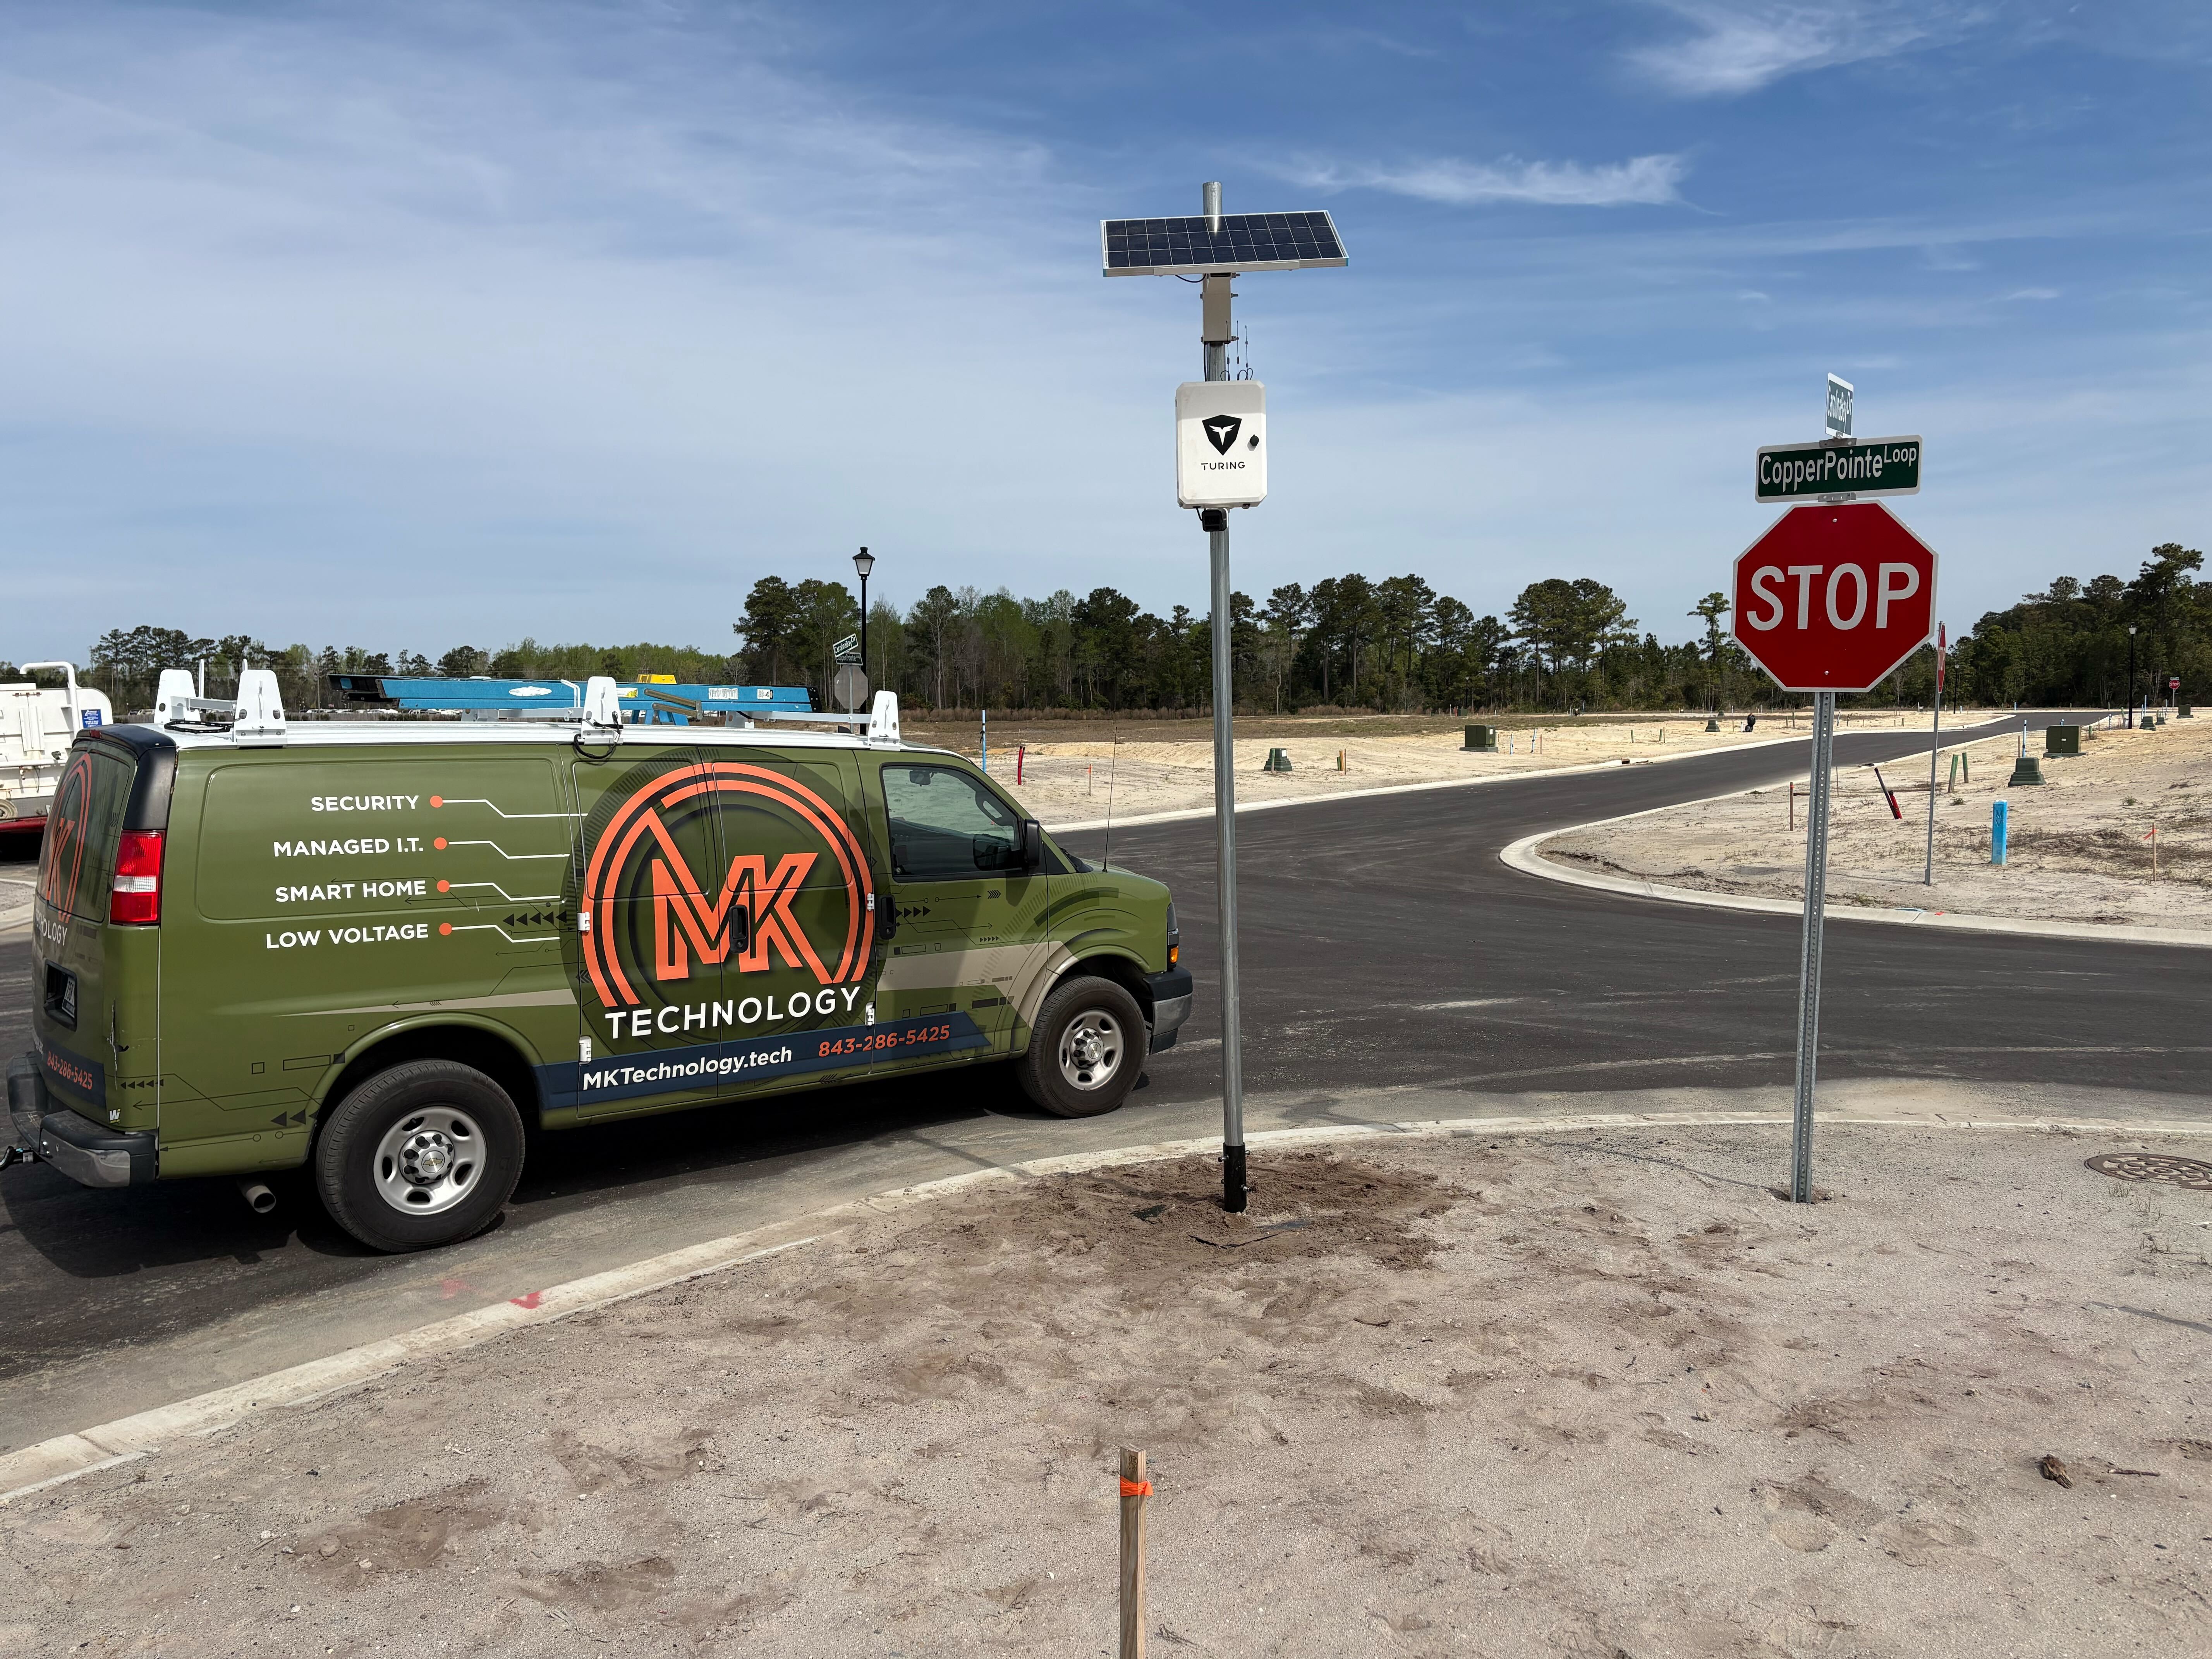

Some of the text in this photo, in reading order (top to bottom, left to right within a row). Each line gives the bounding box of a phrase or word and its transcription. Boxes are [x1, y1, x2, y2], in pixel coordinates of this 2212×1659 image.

[1201, 461, 1245, 471] TURING
[1760, 445, 1917, 493] CopperPointe Loop
[1747, 562, 1920, 631] STOP
[311, 795, 419, 811] SECURITY
[273, 837, 424, 857] MANAGED I.T.
[275, 880, 426, 902] SMART HOME
[266, 923, 429, 949] LOW VOLTAGE
[652, 850, 835, 984] MK
[605, 986, 861, 1039] TECHNOLOGY
[47, 1051, 93, 1090] 843-286-5425
[582, 1025, 950, 1090] MKTechnology.tech 843-286-5425
